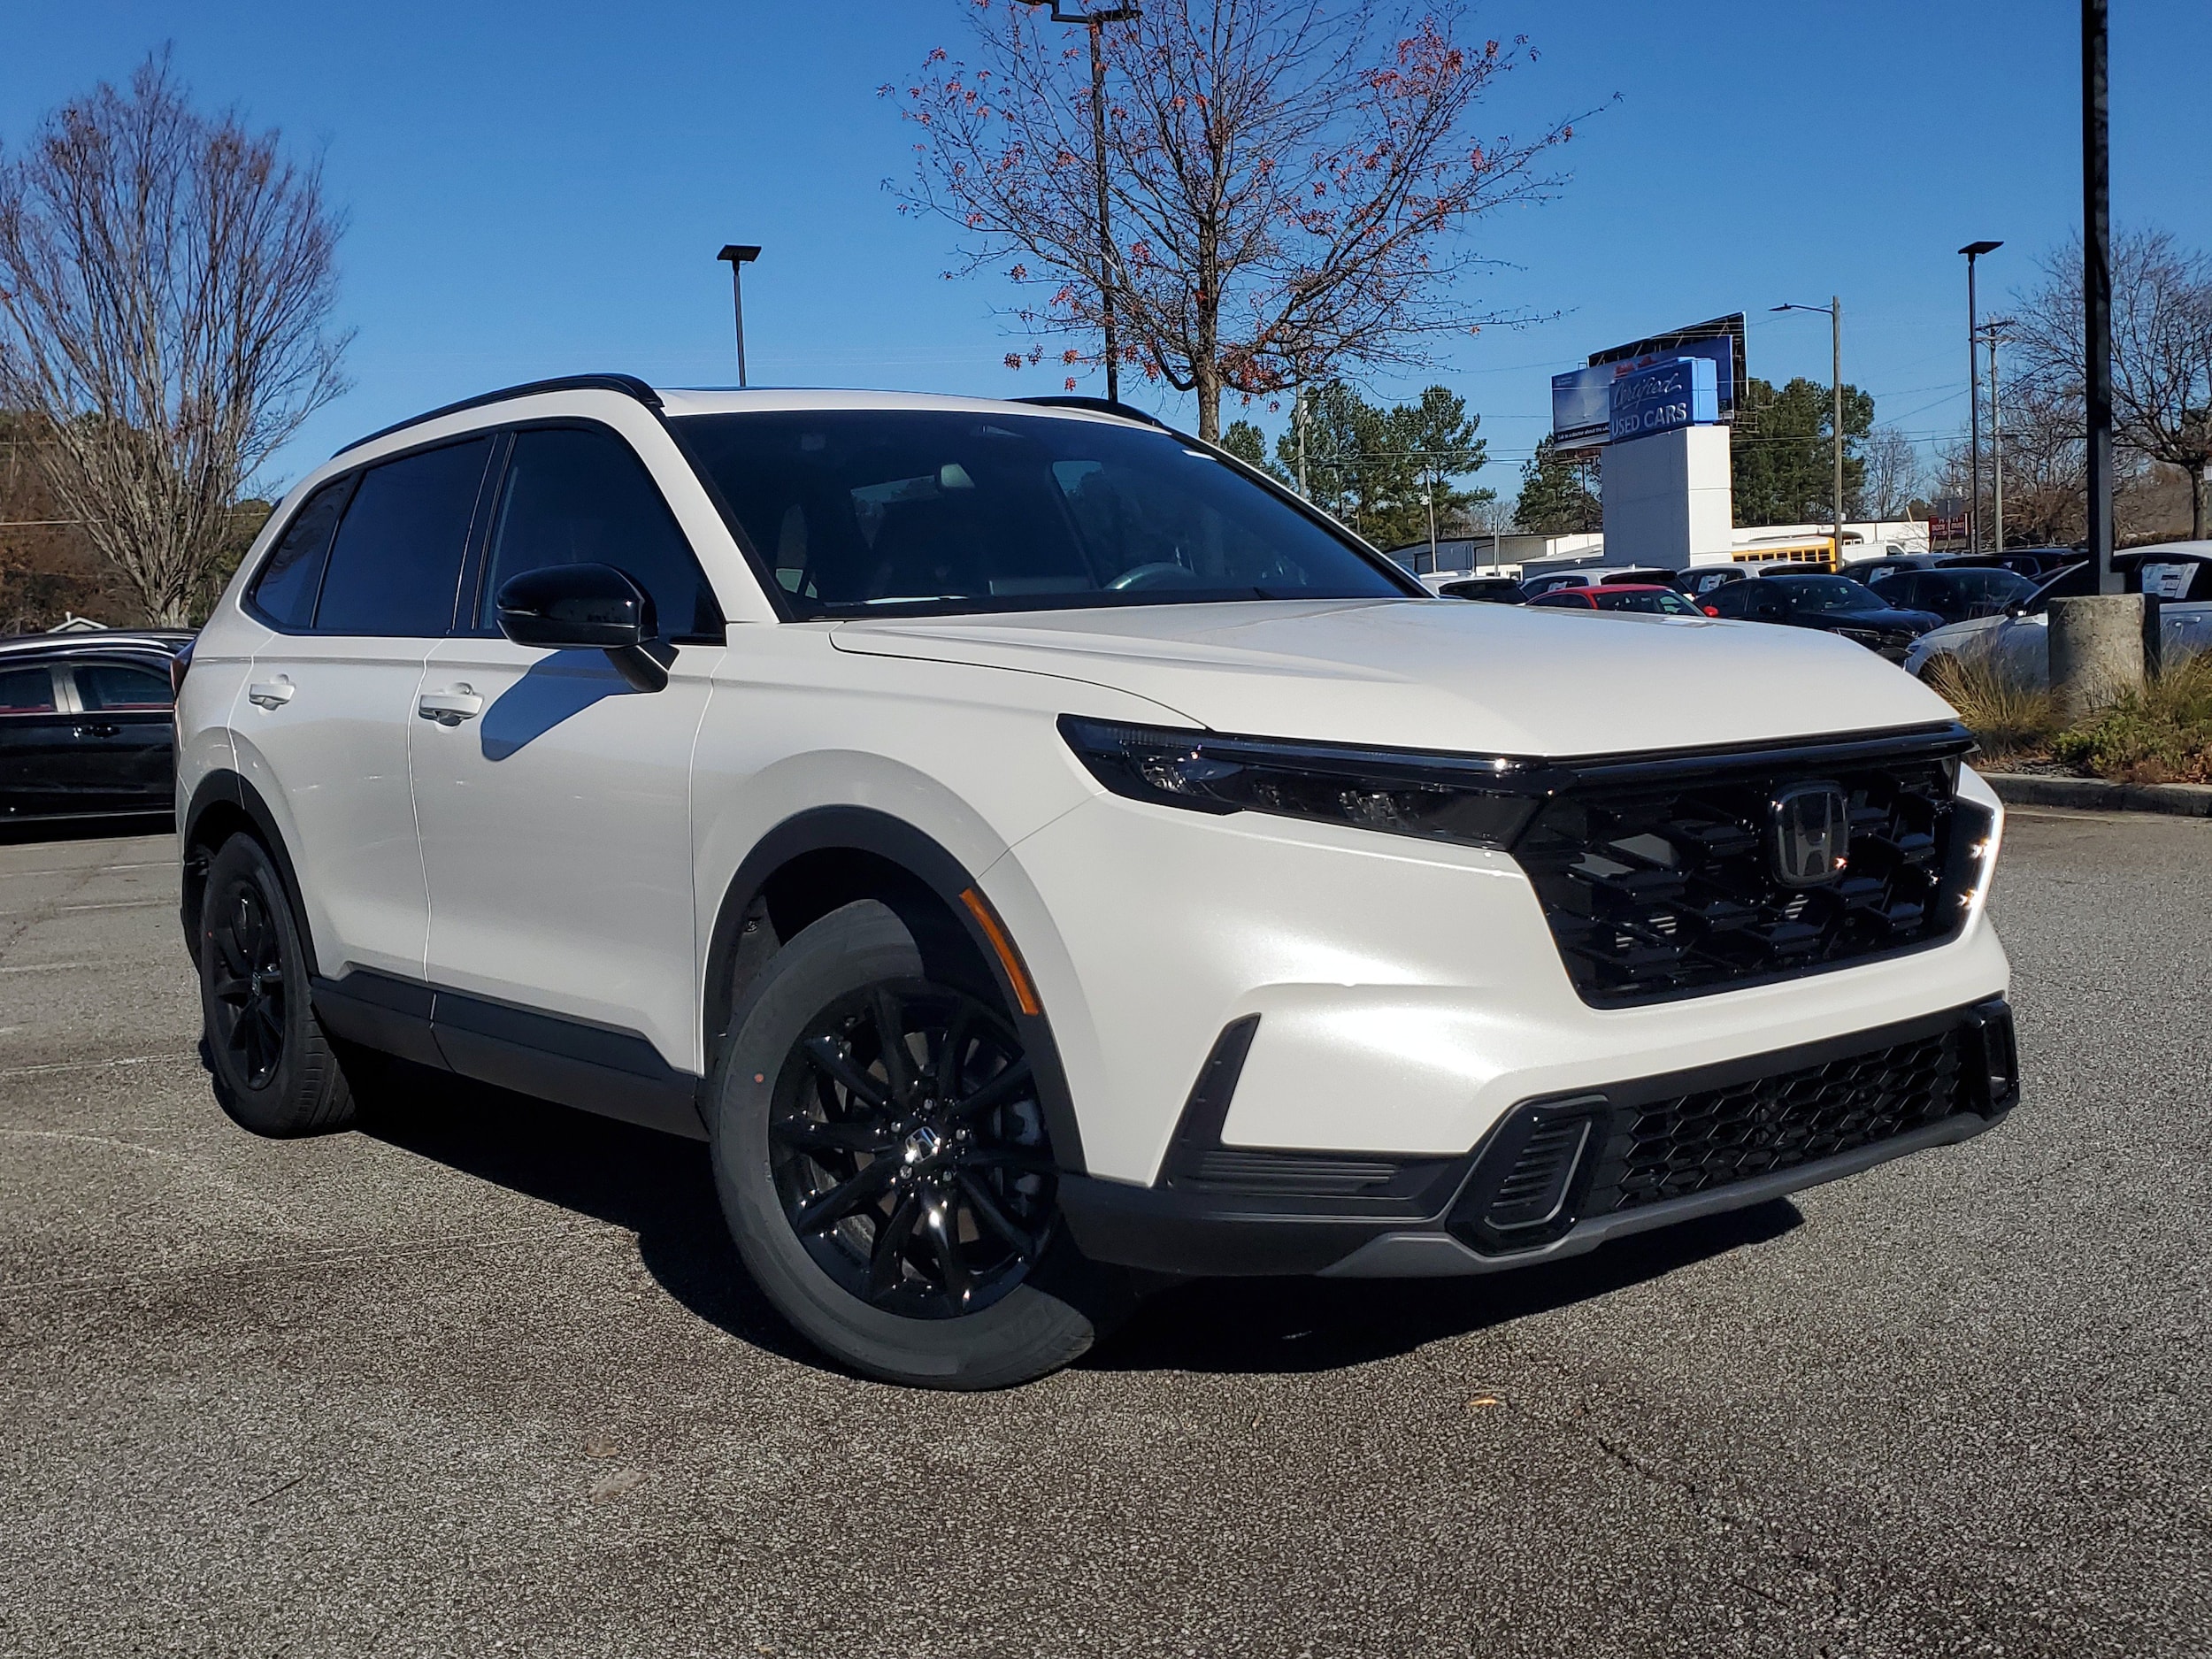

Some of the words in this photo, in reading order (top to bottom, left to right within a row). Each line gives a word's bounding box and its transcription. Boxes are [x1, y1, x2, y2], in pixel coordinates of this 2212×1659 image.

[1614, 373, 1682, 409] Certified
[1611, 414, 1640, 436] USED
[1643, 402, 1687, 427] CARS
